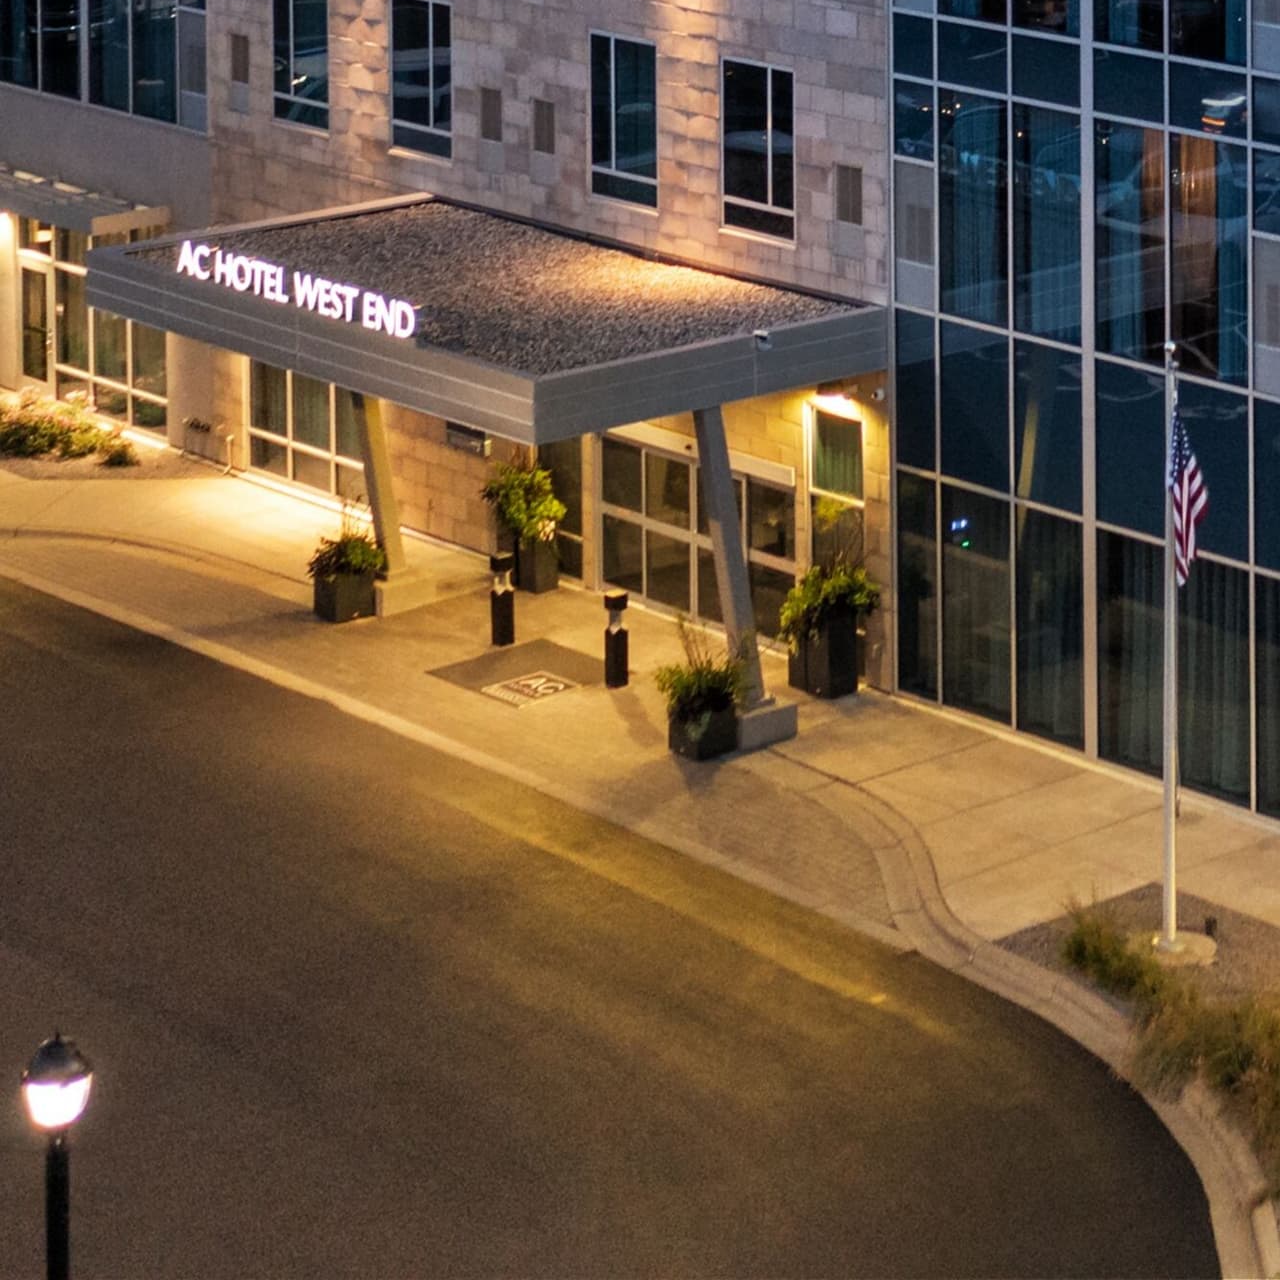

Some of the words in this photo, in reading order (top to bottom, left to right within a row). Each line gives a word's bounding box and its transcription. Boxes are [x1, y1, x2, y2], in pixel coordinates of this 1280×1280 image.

[177, 239, 211, 280] AC
[214, 249, 289, 304] HOTEL
[293, 270, 361, 323] WEST
[362, 291, 416, 338] END
